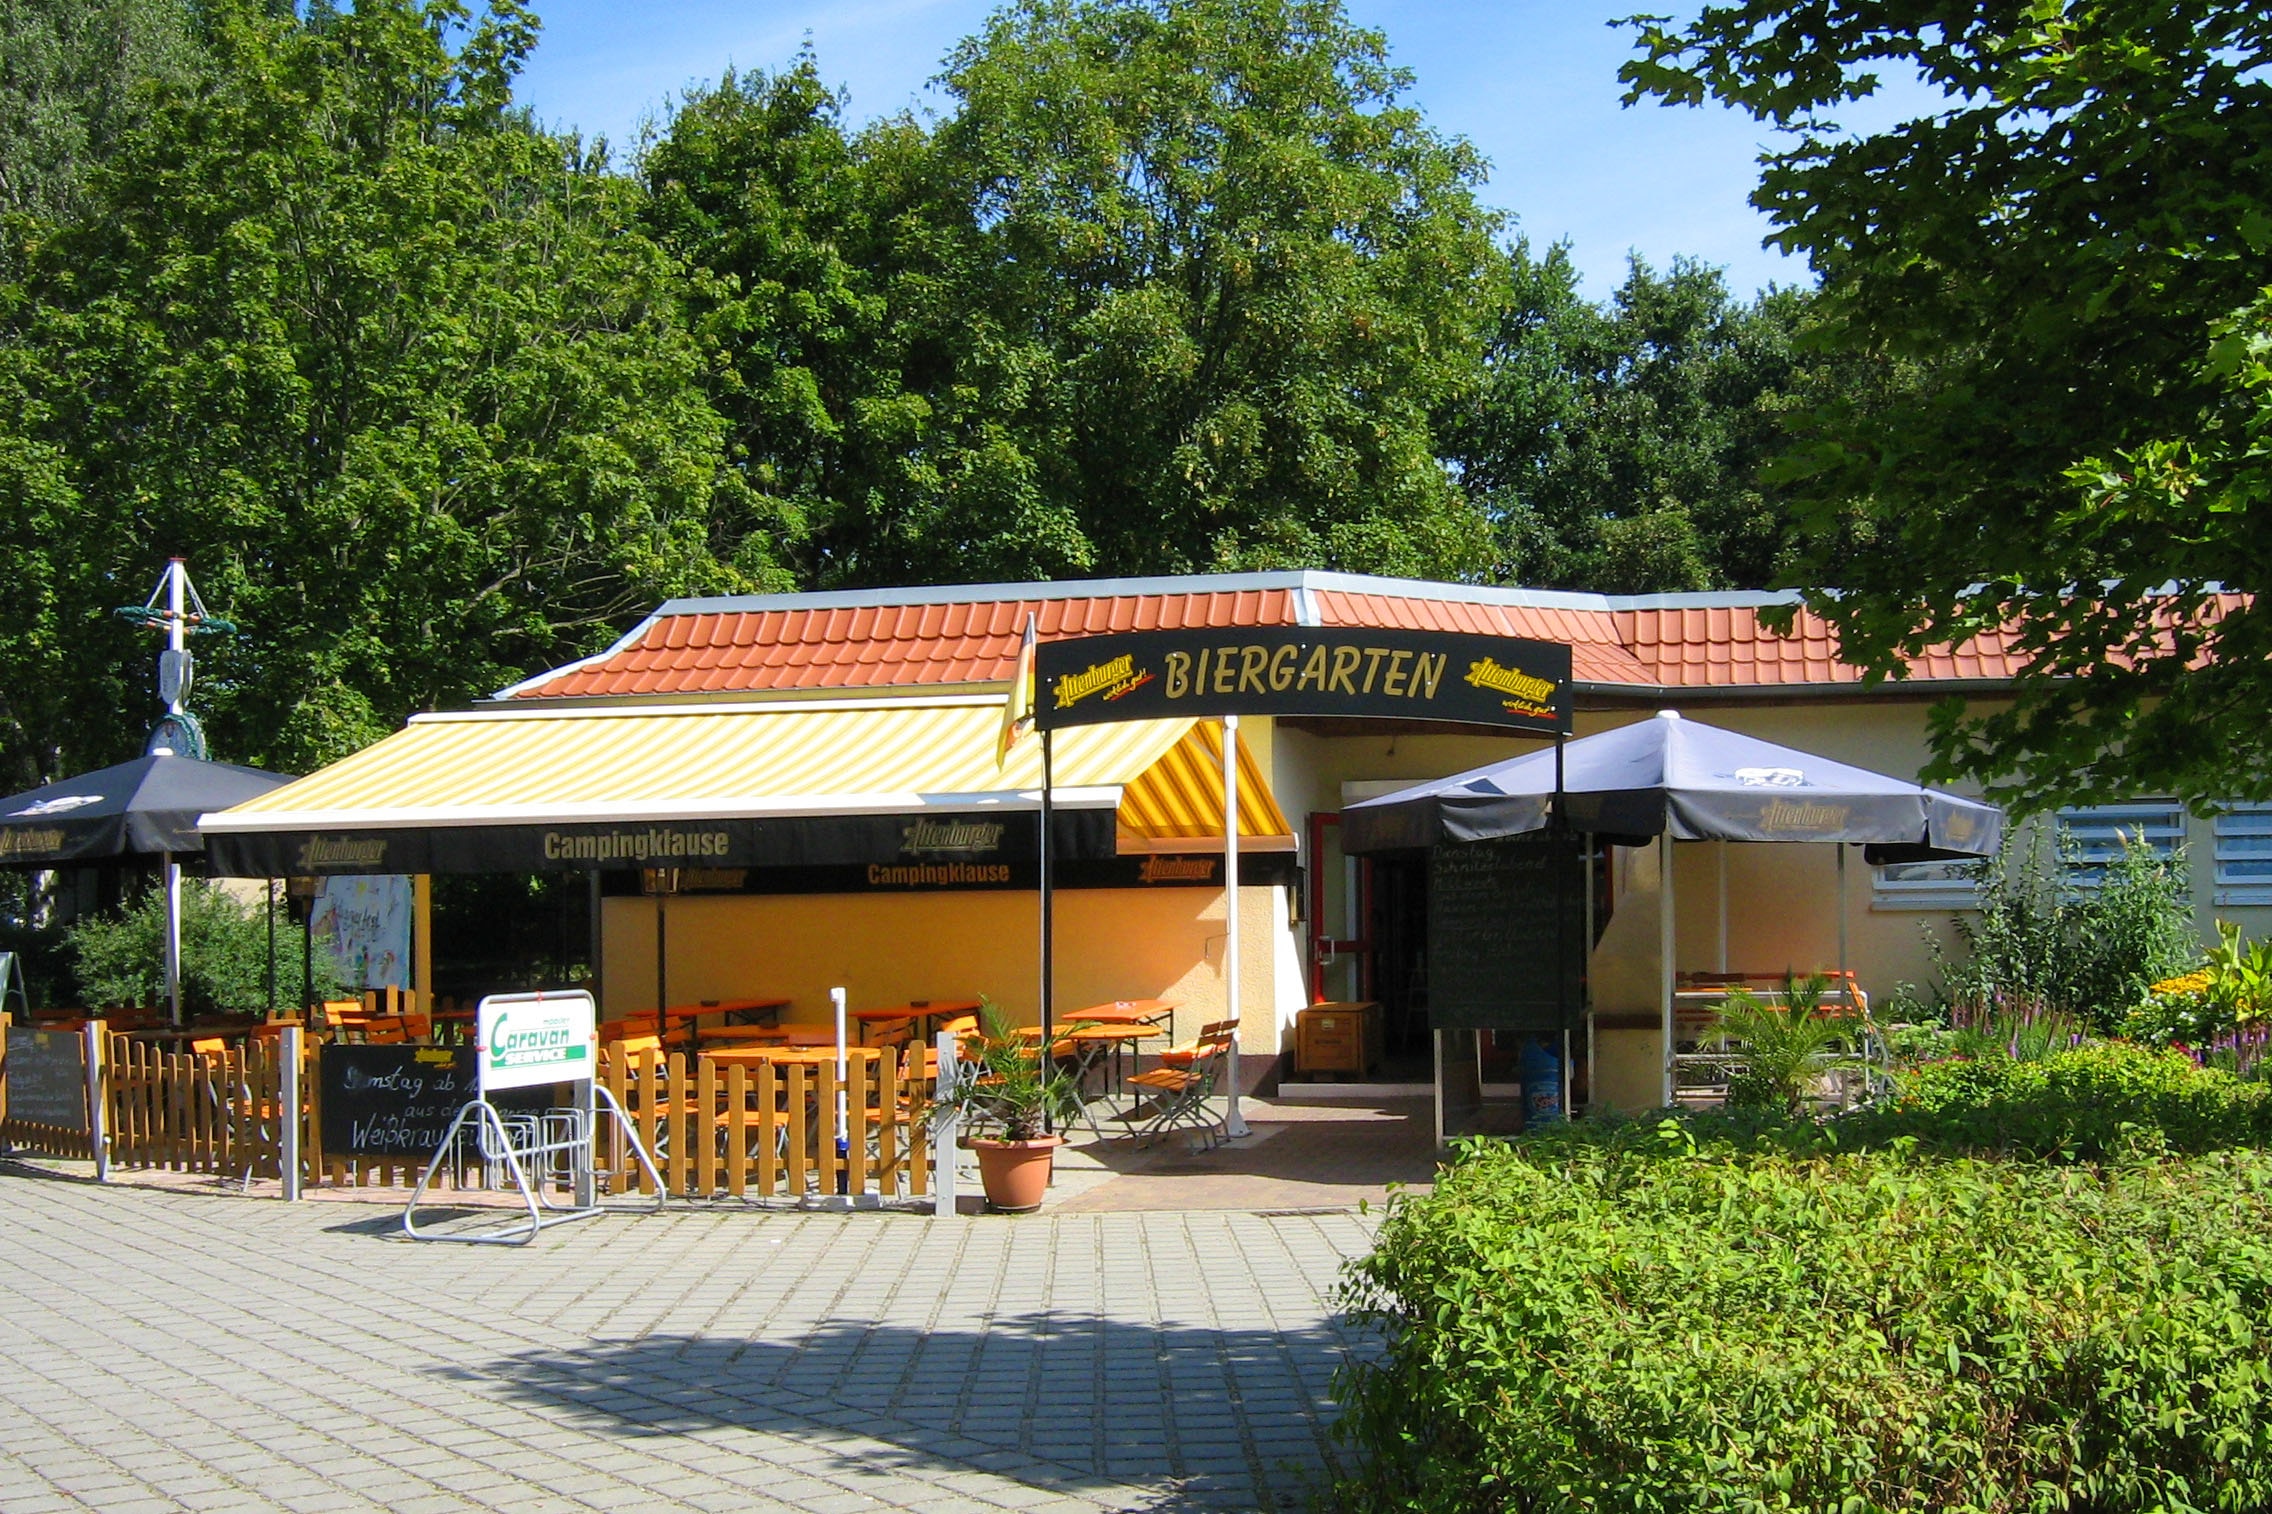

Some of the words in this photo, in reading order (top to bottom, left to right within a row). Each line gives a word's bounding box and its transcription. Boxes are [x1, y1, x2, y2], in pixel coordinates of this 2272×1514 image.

[1053, 653, 1135, 708] Altenburger
[1164, 644, 1448, 700] BIERGARTEN
[1463, 655, 1557, 704] Altenburger
[297, 834, 389, 872] Altenburger
[545, 828, 730, 862] Campingklause
[900, 817, 1005, 856] Altenburger
[867, 862, 1011, 886] Campingklause
[490, 1012, 570, 1058] Caravan
[505, 1046, 567, 1066] SERVICE
[433, 1072, 455, 1092] ab
[404, 1103, 436, 1118] aus
